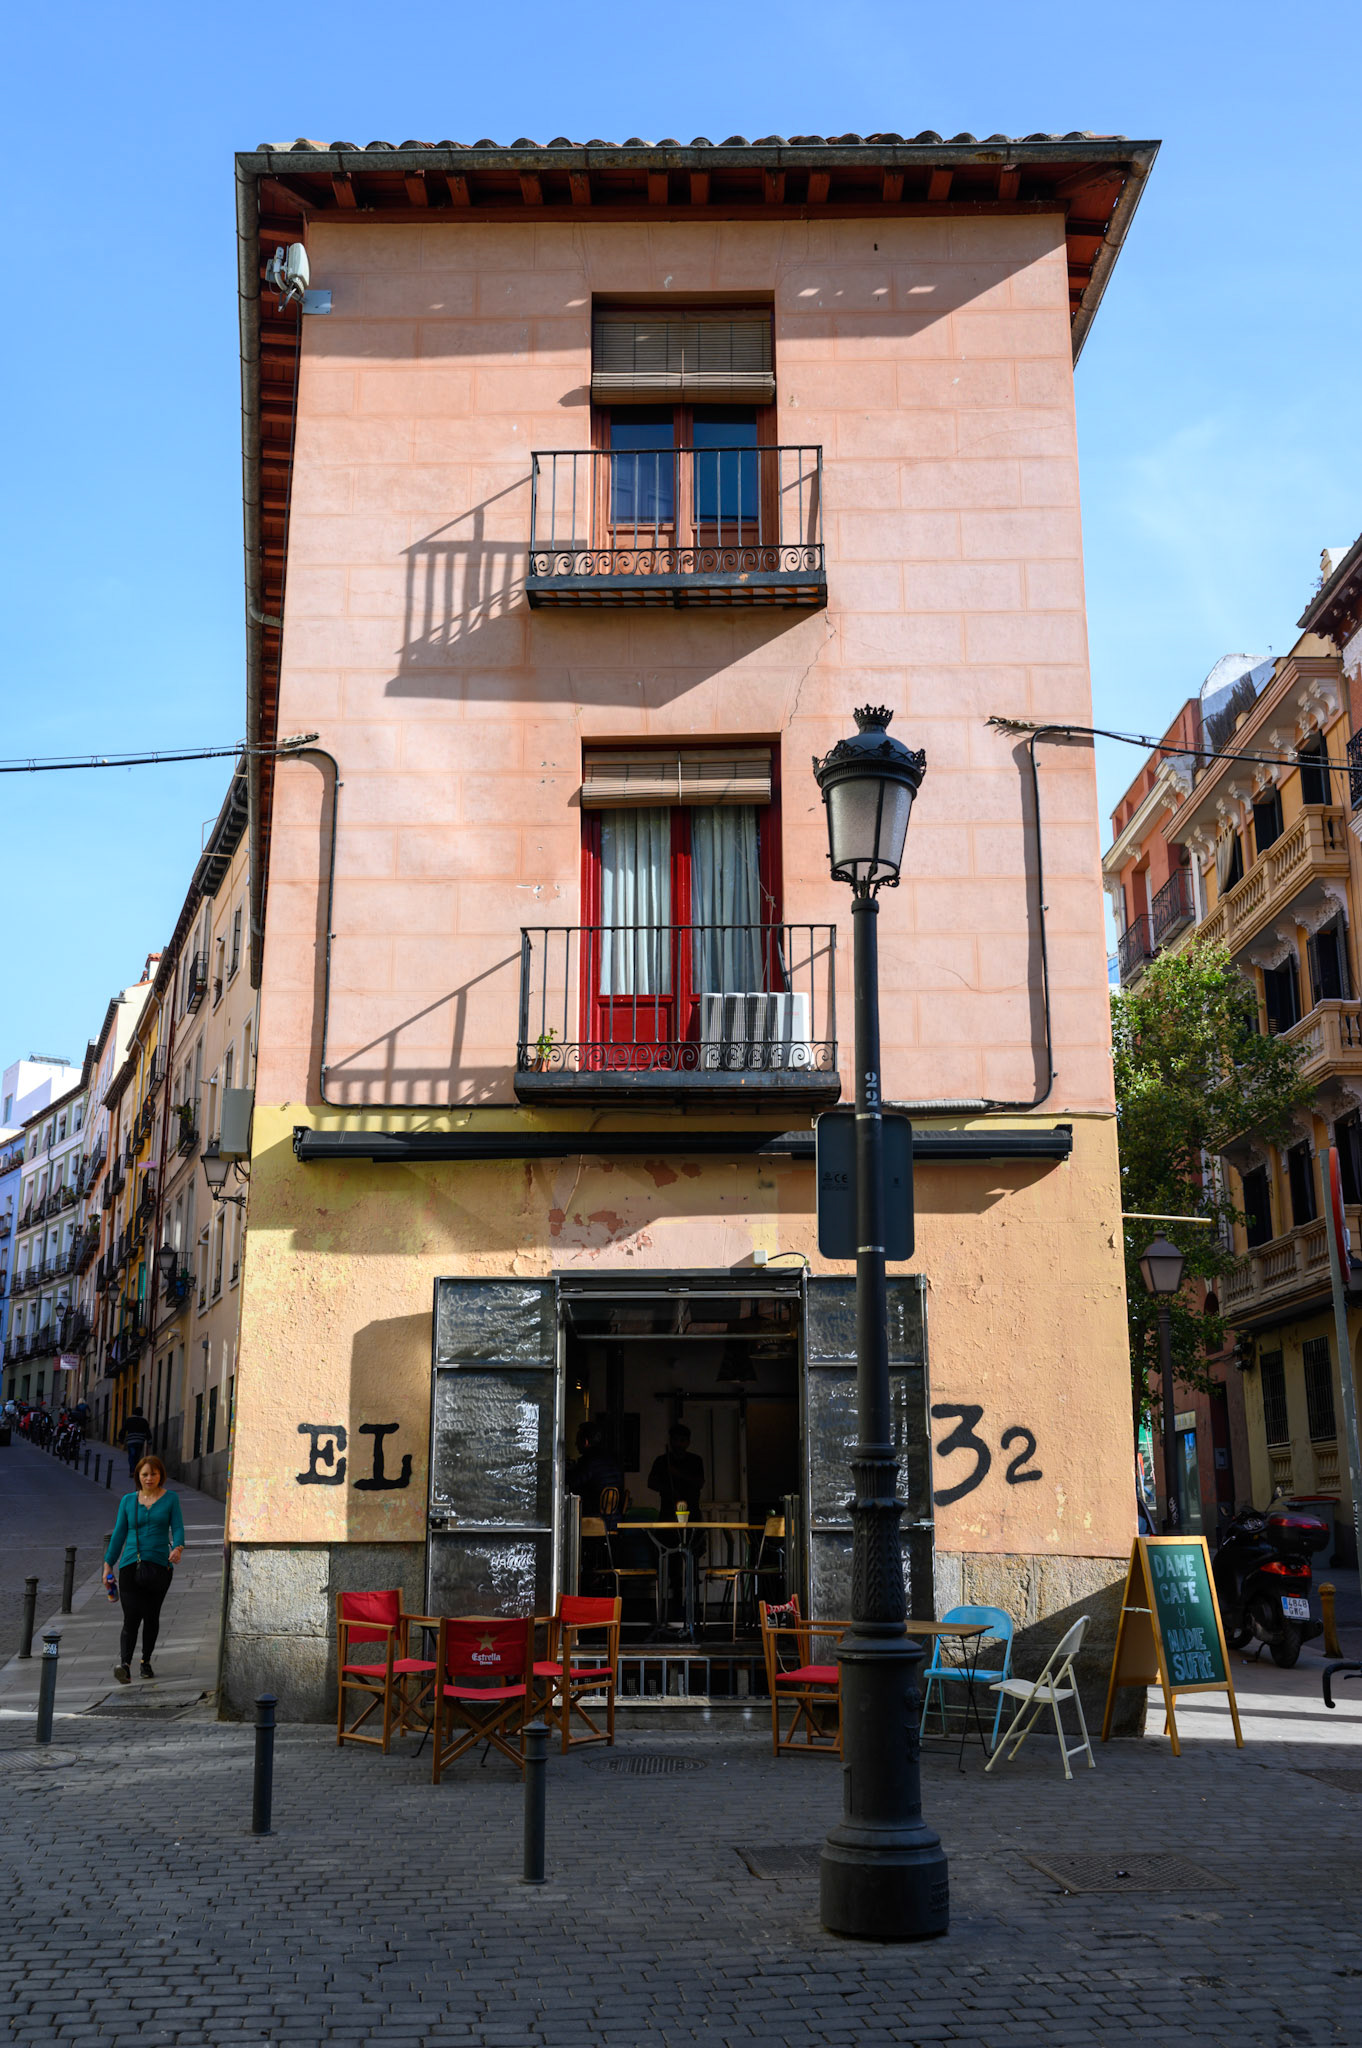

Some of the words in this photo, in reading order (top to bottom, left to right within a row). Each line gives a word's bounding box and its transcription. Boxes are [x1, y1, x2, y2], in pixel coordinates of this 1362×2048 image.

[295, 1423, 413, 1491] EL
[931, 1403, 1043, 1507] 32
[1154, 1555, 1197, 1578] DAME
[1160, 1577, 1200, 1604] CAFÉ
[1168, 1627, 1207, 1652] NADIE
[472, 1652, 501, 1662] Estrella
[1173, 1651, 1215, 1681] SUFRE
